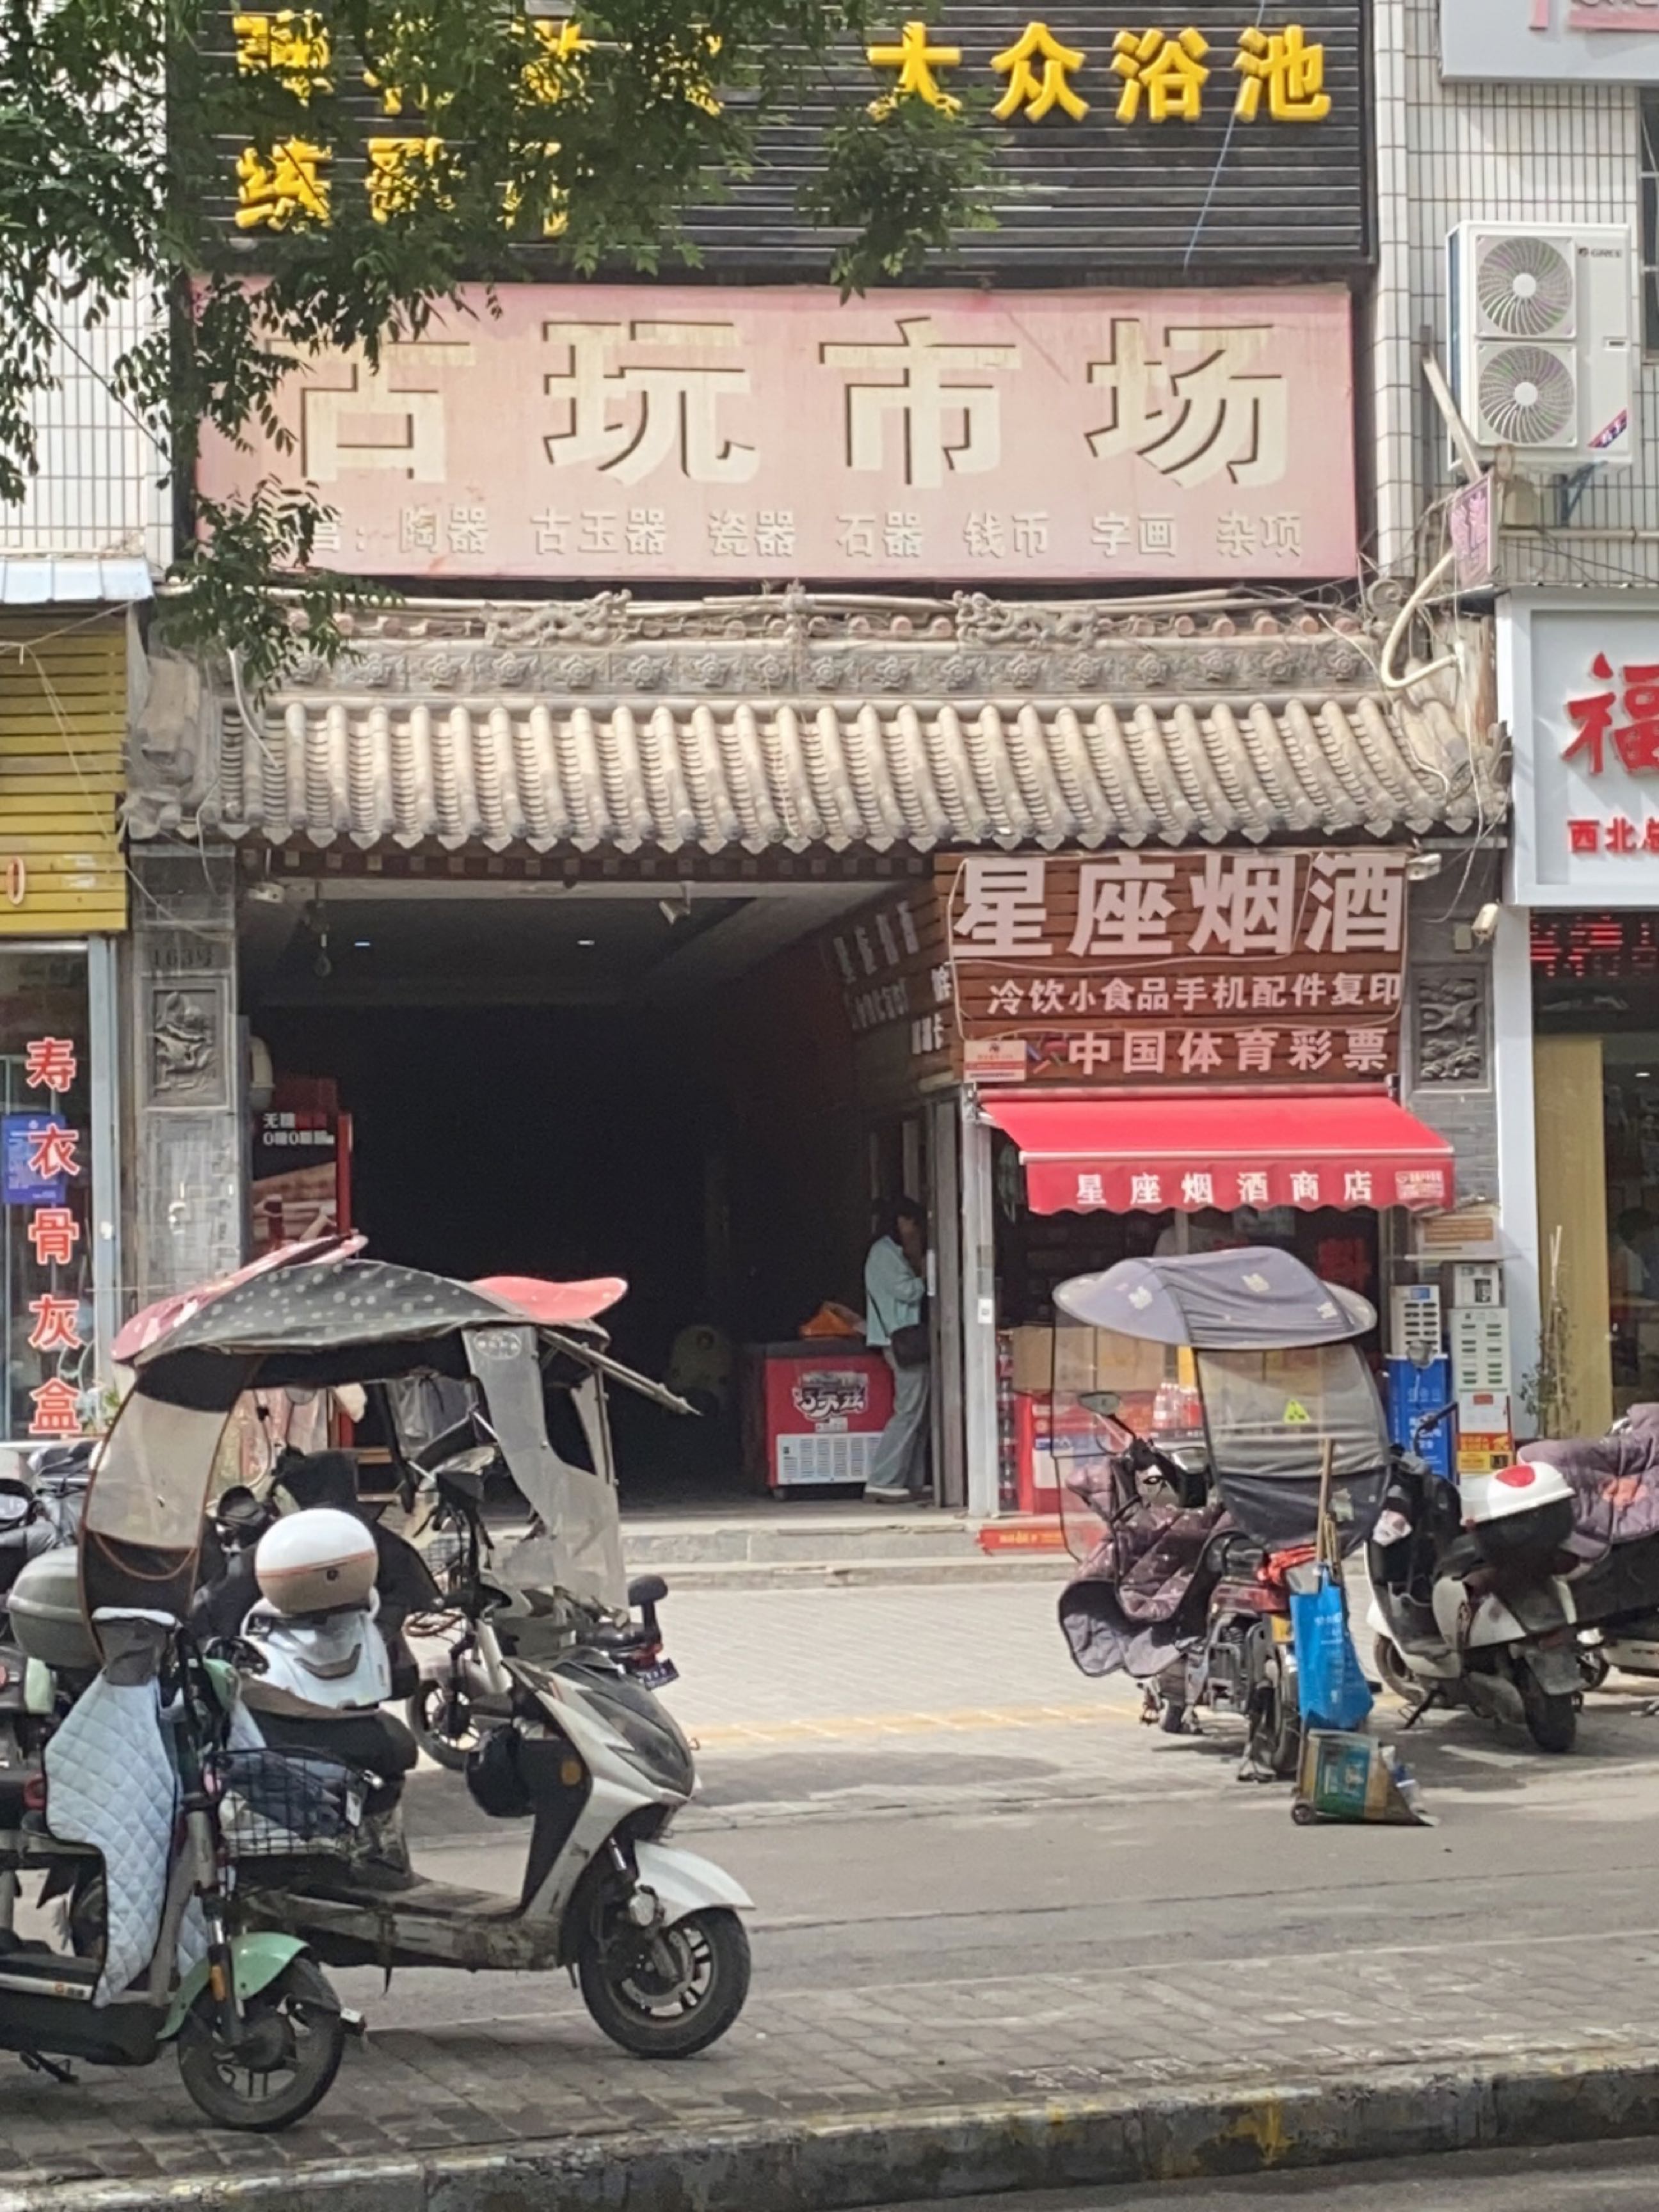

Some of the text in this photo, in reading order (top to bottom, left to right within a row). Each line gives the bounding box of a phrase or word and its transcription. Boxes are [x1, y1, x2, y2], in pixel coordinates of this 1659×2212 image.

[867, 21, 1331, 122] 大众浴池
[262, 315, 1289, 489] 古玩市场
[398, 506, 489, 556] 陶器
[530, 506, 667, 556] 古玉器
[708, 508, 796, 558] 瓷器
[837, 511, 924, 558] 石器
[964, 511, 1050, 559] 钱币
[1091, 511, 1178, 558] 字画
[1216, 511, 1303, 559] 杂项
[1560, 652, 1659, 774] 福
[952, 852, 1406, 958] 星座烟酒
[987, 972, 1401, 1015] 冷饮小食品手机配件复印
[1068, 1028, 1388, 1076] 中国体育彩票
[26, 1036, 81, 1435] 寿衣骨灰盒
[1076, 1170, 1372, 1206] 星座烟酒商店
